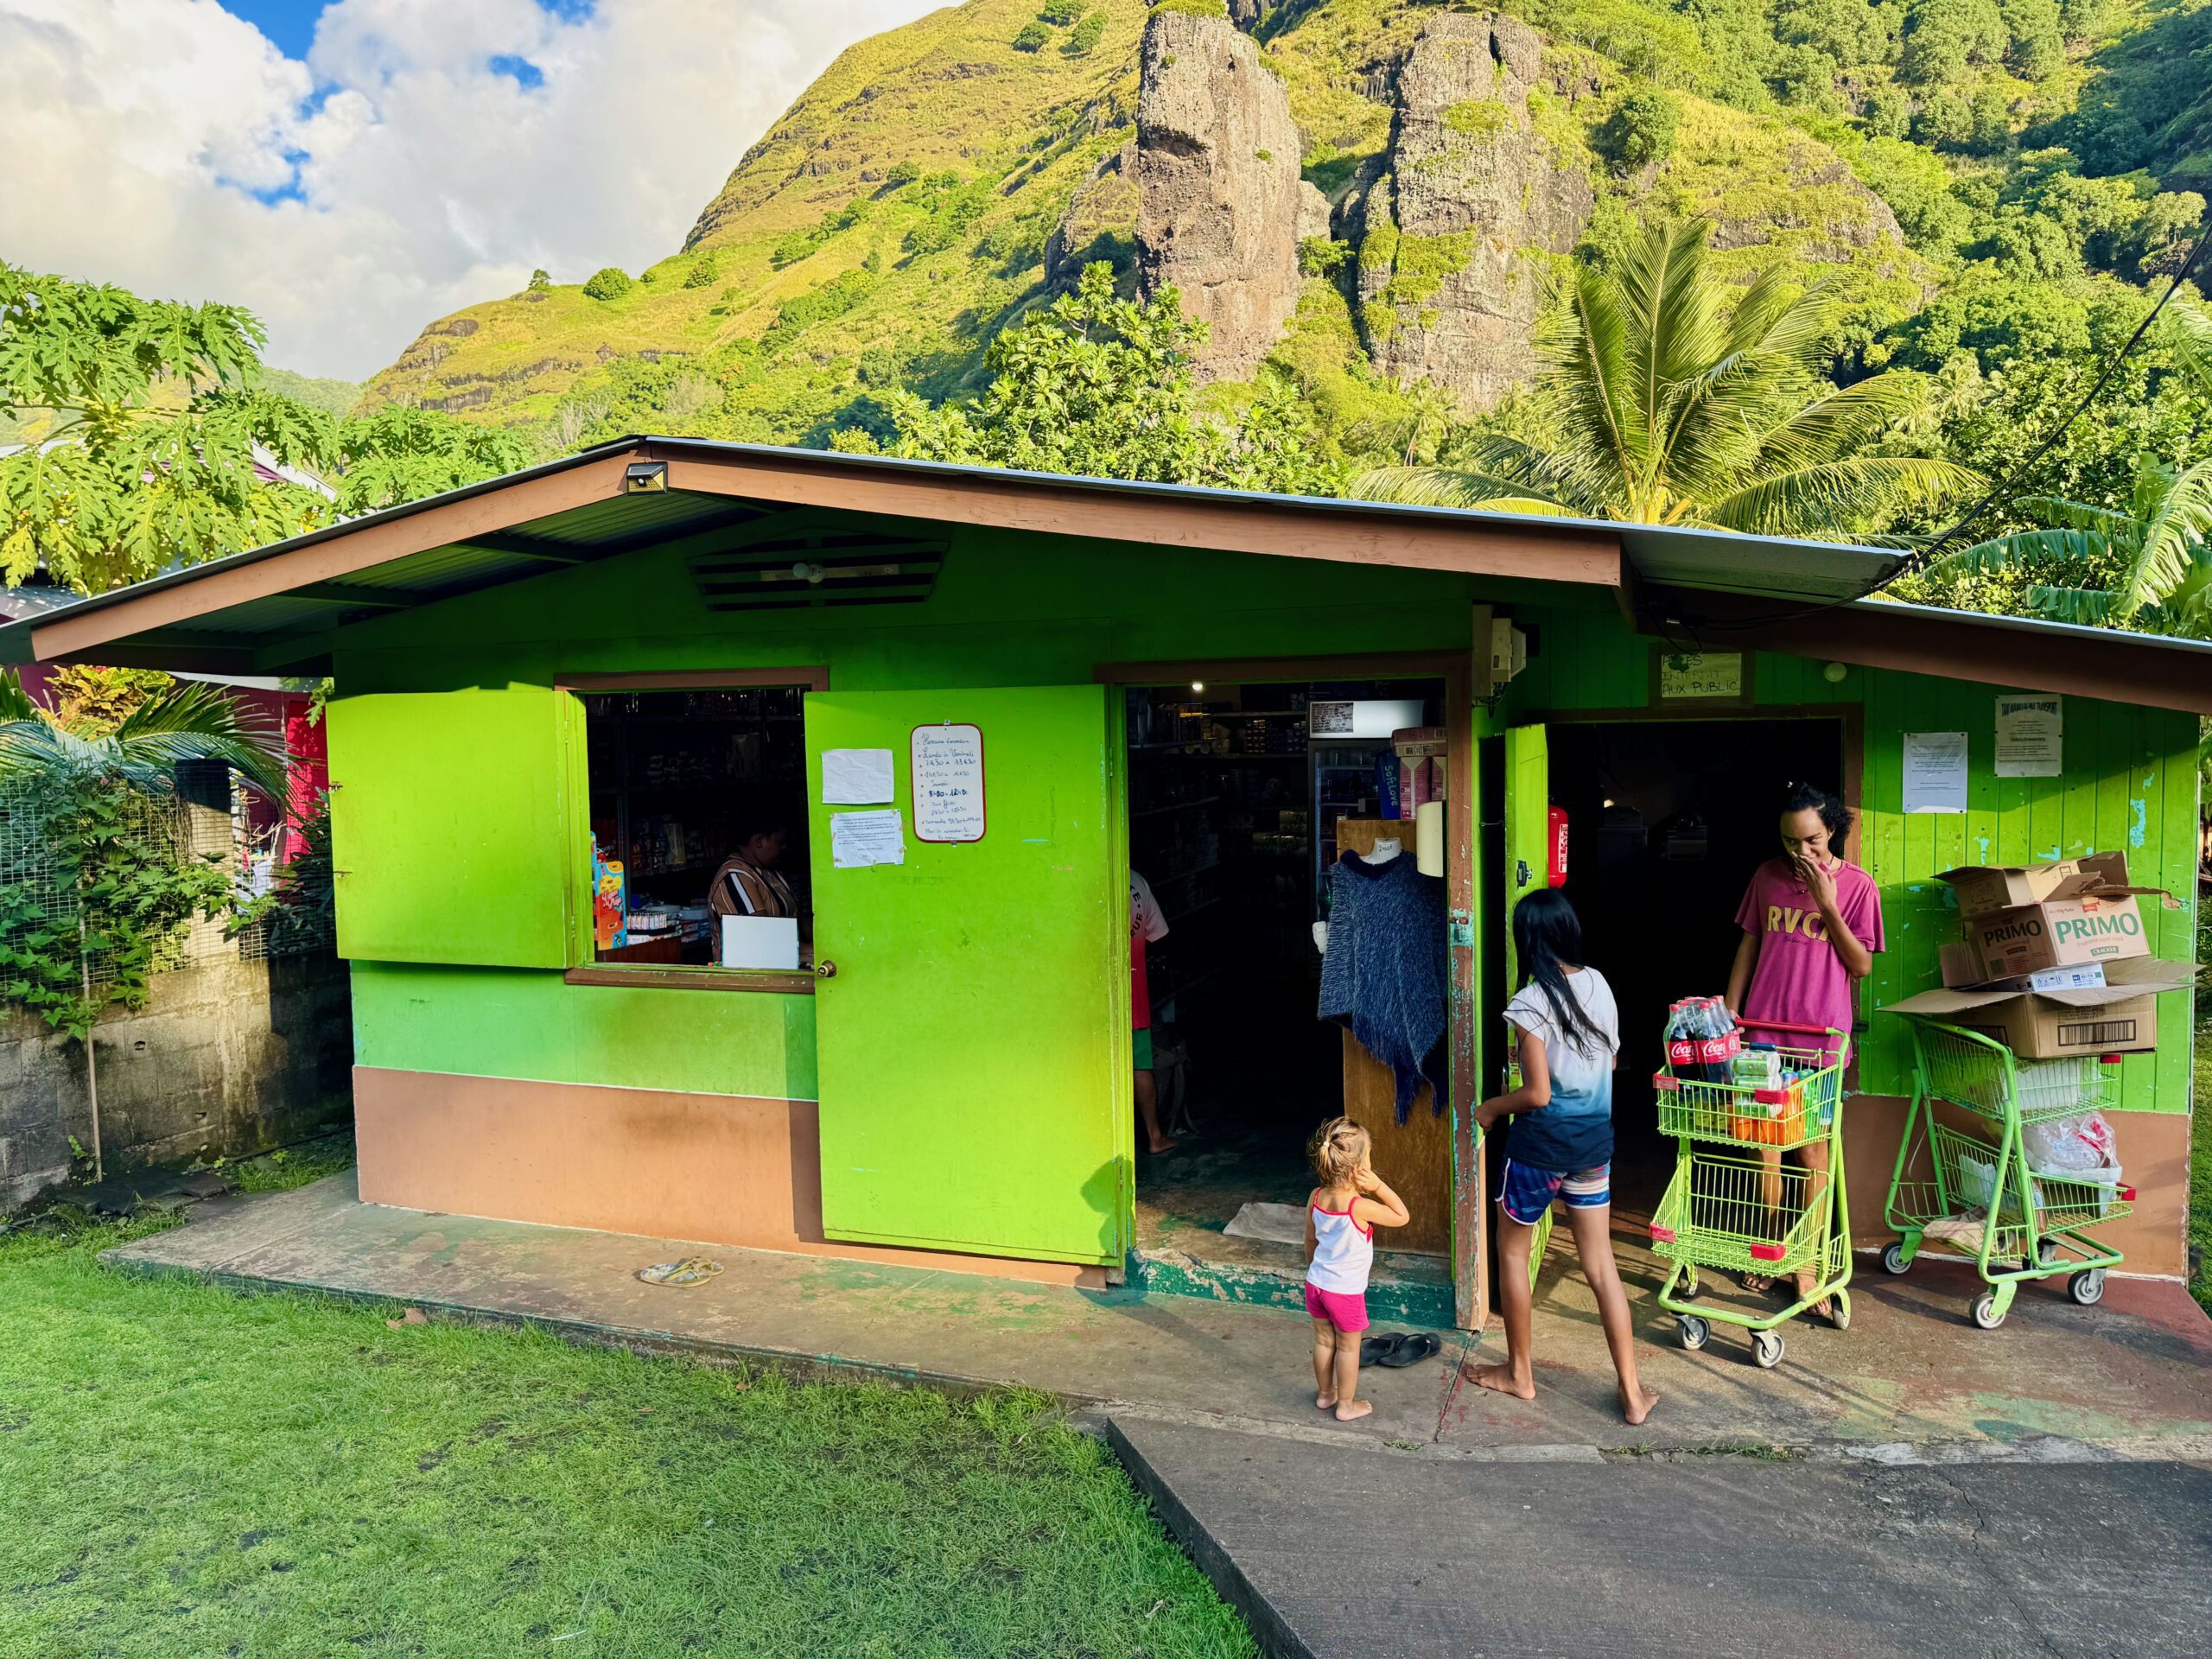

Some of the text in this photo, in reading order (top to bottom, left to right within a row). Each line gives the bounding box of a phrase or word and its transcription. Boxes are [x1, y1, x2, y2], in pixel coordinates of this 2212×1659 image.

[1662, 655, 1703, 666] AES
[1662, 681, 1738, 695] AUX PUBLIC
[1983, 919, 2042, 947] PRIMO
[2054, 912, 2139, 945] PRIMO
